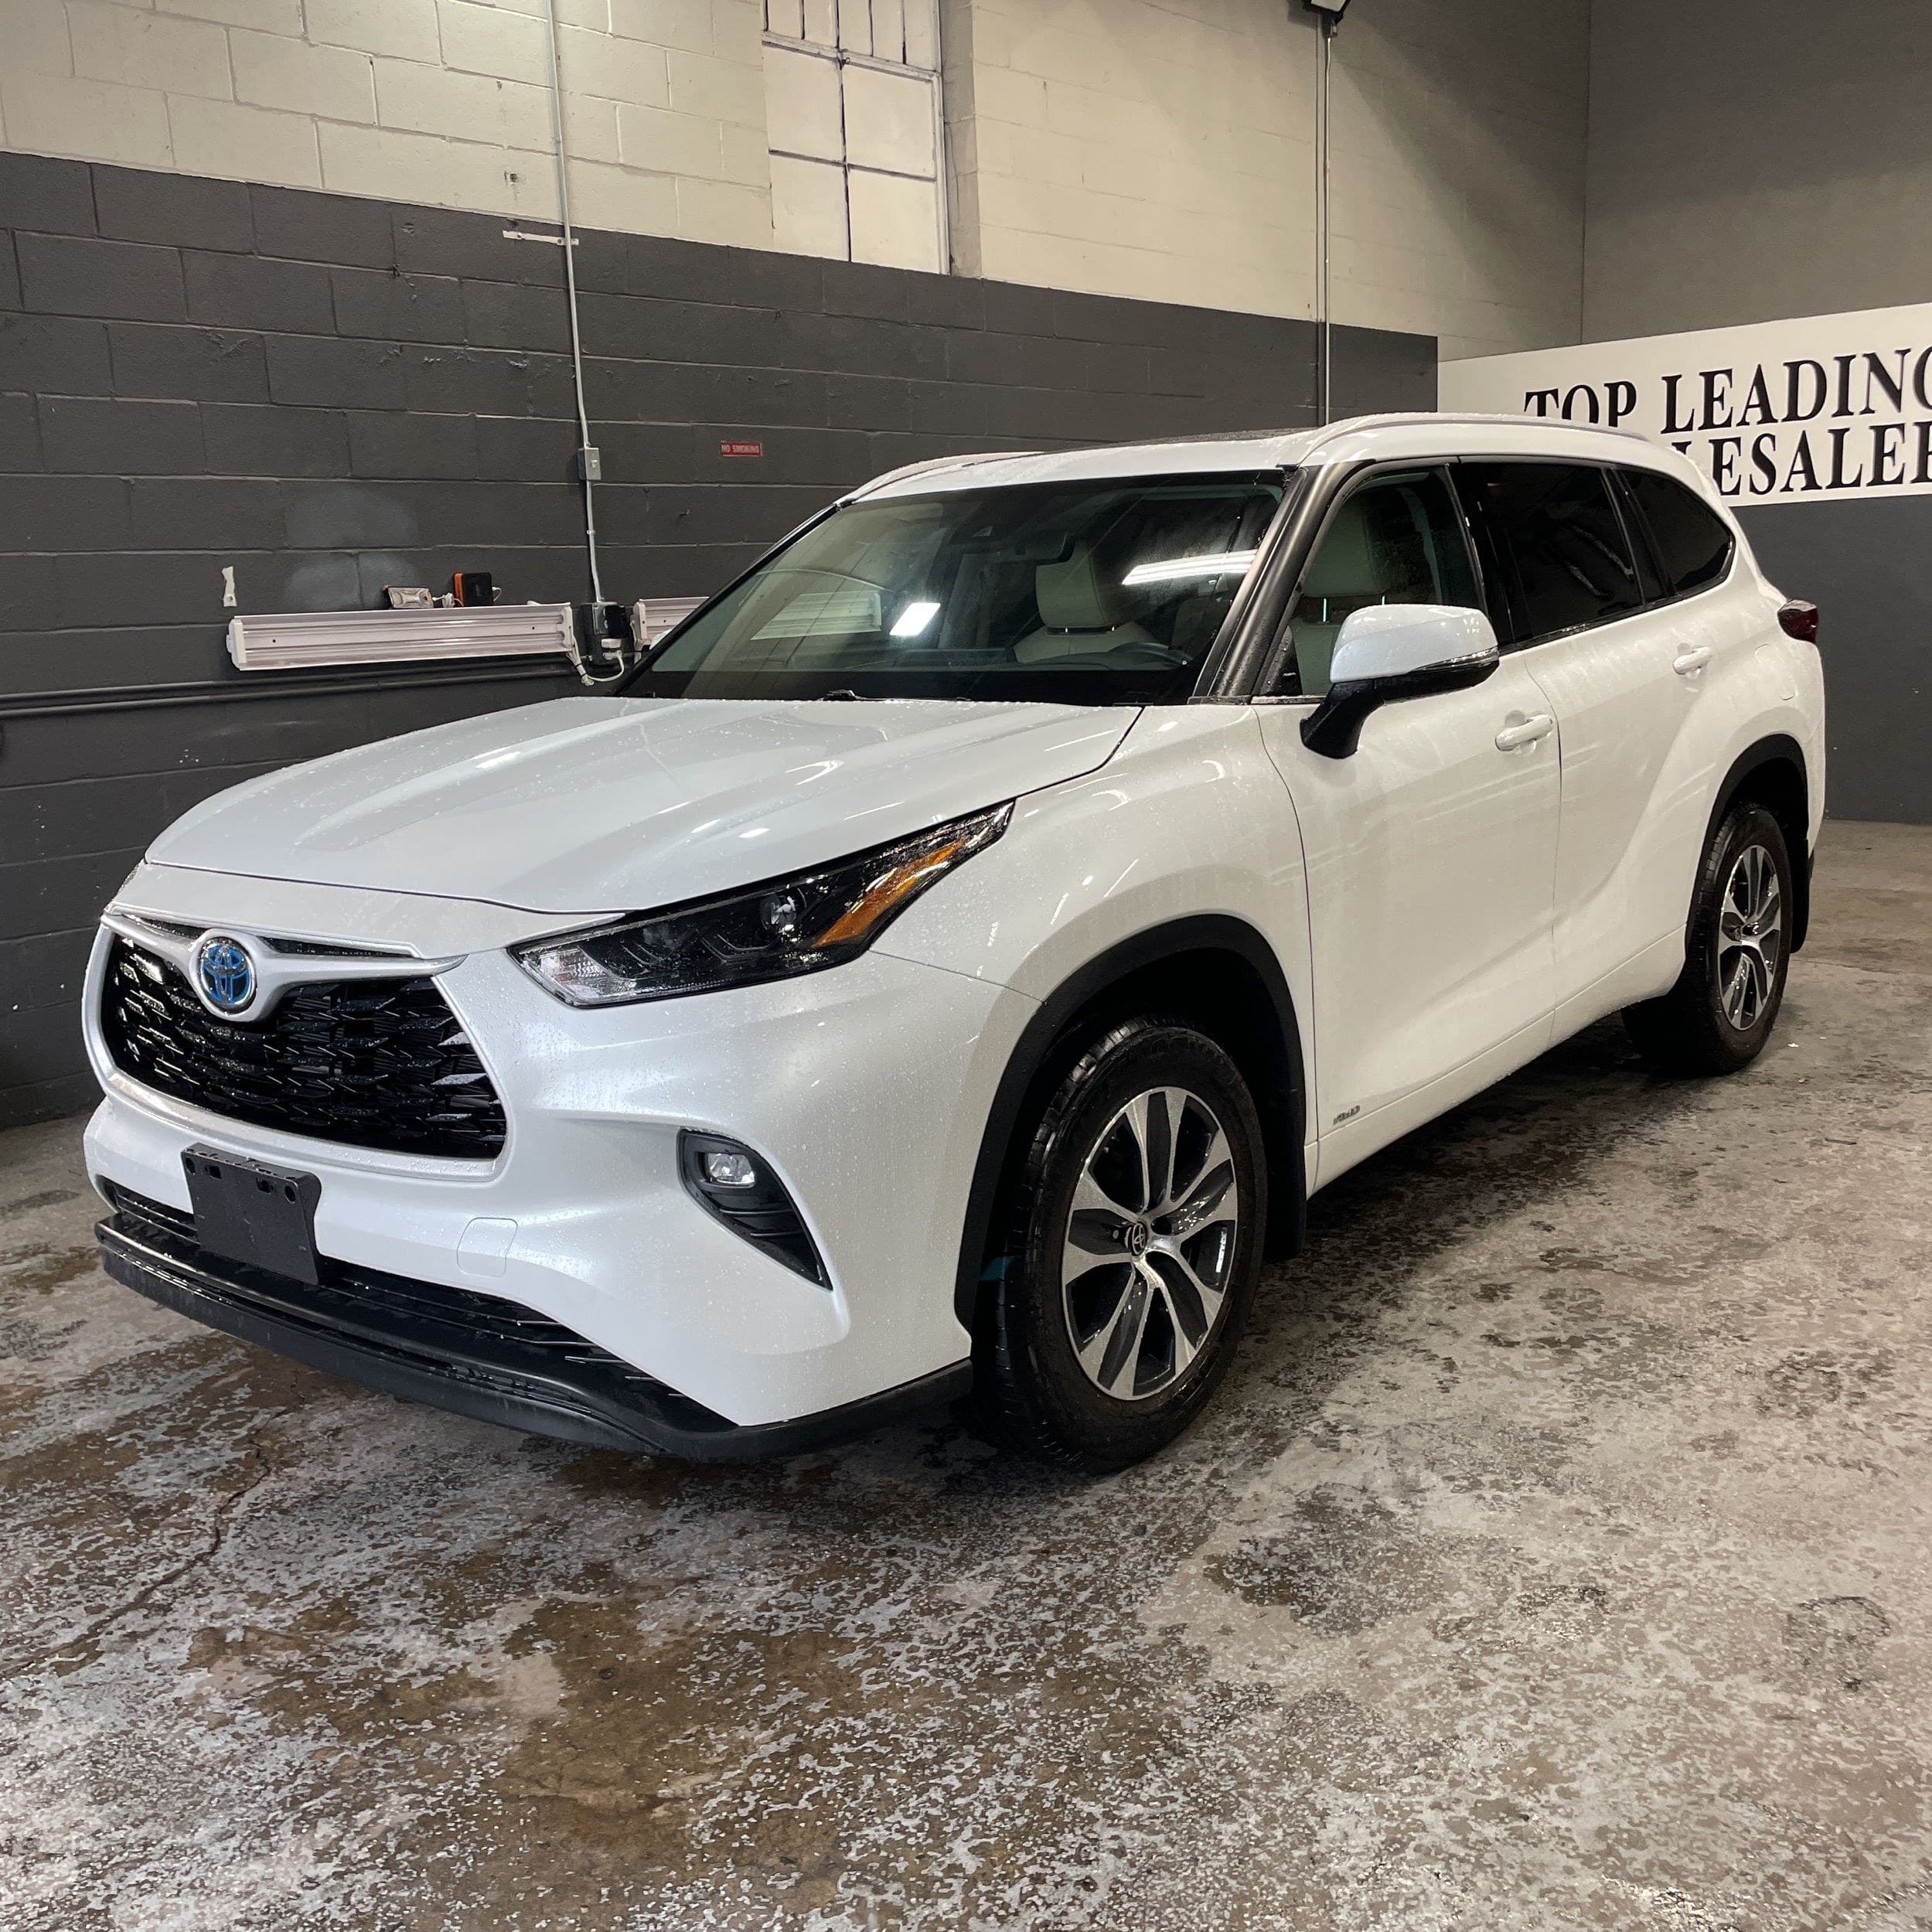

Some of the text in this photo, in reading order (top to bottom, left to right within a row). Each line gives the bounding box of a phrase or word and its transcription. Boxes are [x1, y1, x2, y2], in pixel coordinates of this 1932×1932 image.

[1524, 380, 1637, 428] TOP
[721, 445, 759, 453] NO SMOKING
[1671, 420, 1932, 496] ESALE
